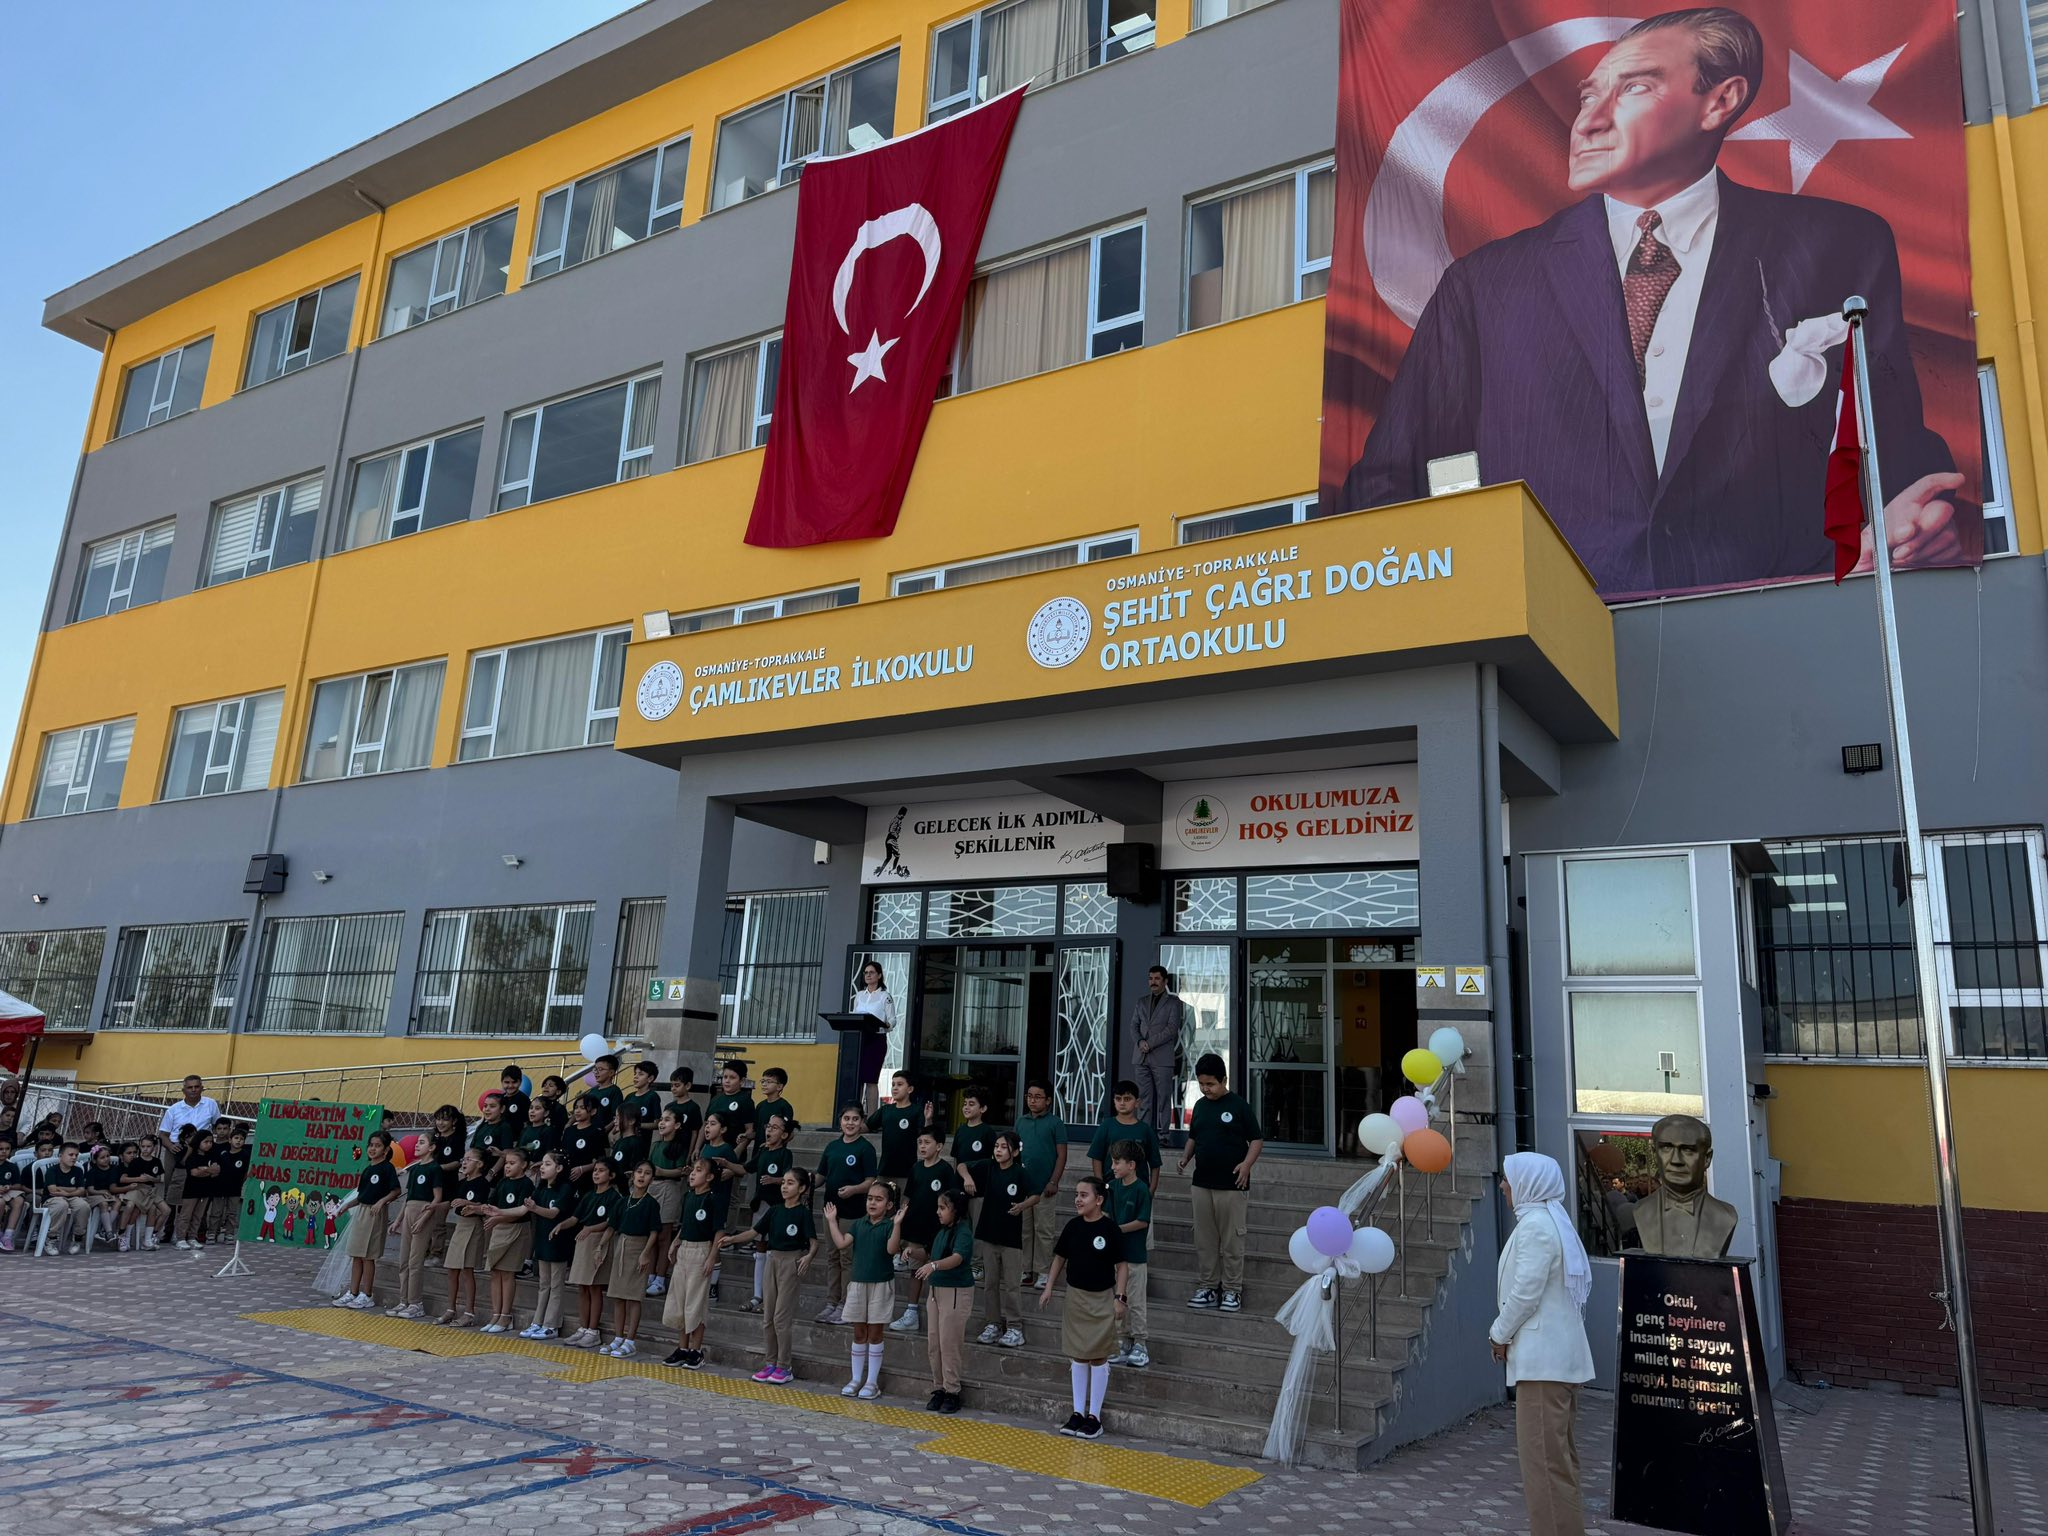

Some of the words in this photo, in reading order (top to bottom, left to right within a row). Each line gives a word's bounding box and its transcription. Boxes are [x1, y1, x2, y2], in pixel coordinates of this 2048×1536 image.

[1106, 546, 1299, 592] OSMANİYE-TOPRAKKALE
[1103, 589, 1193, 634] ŞEHİT
[1205, 568, 1312, 619] ÇAĞRI
[1324, 546, 1454, 597] DOĞAN
[1100, 619, 1287, 672] ORTAOKULU
[694, 647, 826, 678] OSMANİYE-TOPRAKKALE
[689, 666, 841, 716] ÇAMLIKEVLER
[851, 645, 975, 688] İLKOKULU
[1250, 786, 1401, 812] OKULUMUZA
[914, 816, 994, 836] GELECEK
[996, 810, 1029, 832] İLK
[1032, 806, 1105, 828] ADIMLA
[1238, 818, 1289, 843] HOŞ
[1295, 808, 1414, 839] GELDİNİZ
[954, 833, 1056, 858] ŞEKİLLENİR
[269, 1100, 347, 1122] İLKÖĞRETİM
[305, 1124, 365, 1141] HAFTASI
[258, 1143, 278, 1158] EN
[280, 1142, 339, 1164] DEĞERLİ
[250, 1163, 292, 1183] MİRAS
[1636, 1313, 1665, 1329] genç
[1668, 1314, 1726, 1331] beyinlere
[1629, 1330, 1684, 1350] insanlığa
[1687, 1338, 1735, 1355] saygıyı,
[1634, 1352, 1669, 1366] millet
[1672, 1357, 1686, 1368] ve
[1690, 1356, 1732, 1375] ülkeye
[1623, 1371, 1668, 1389] sevgiyi,
[1672, 1375, 1743, 1396] bağımsızlık
[1631, 1393, 1685, 1409] onurunu
